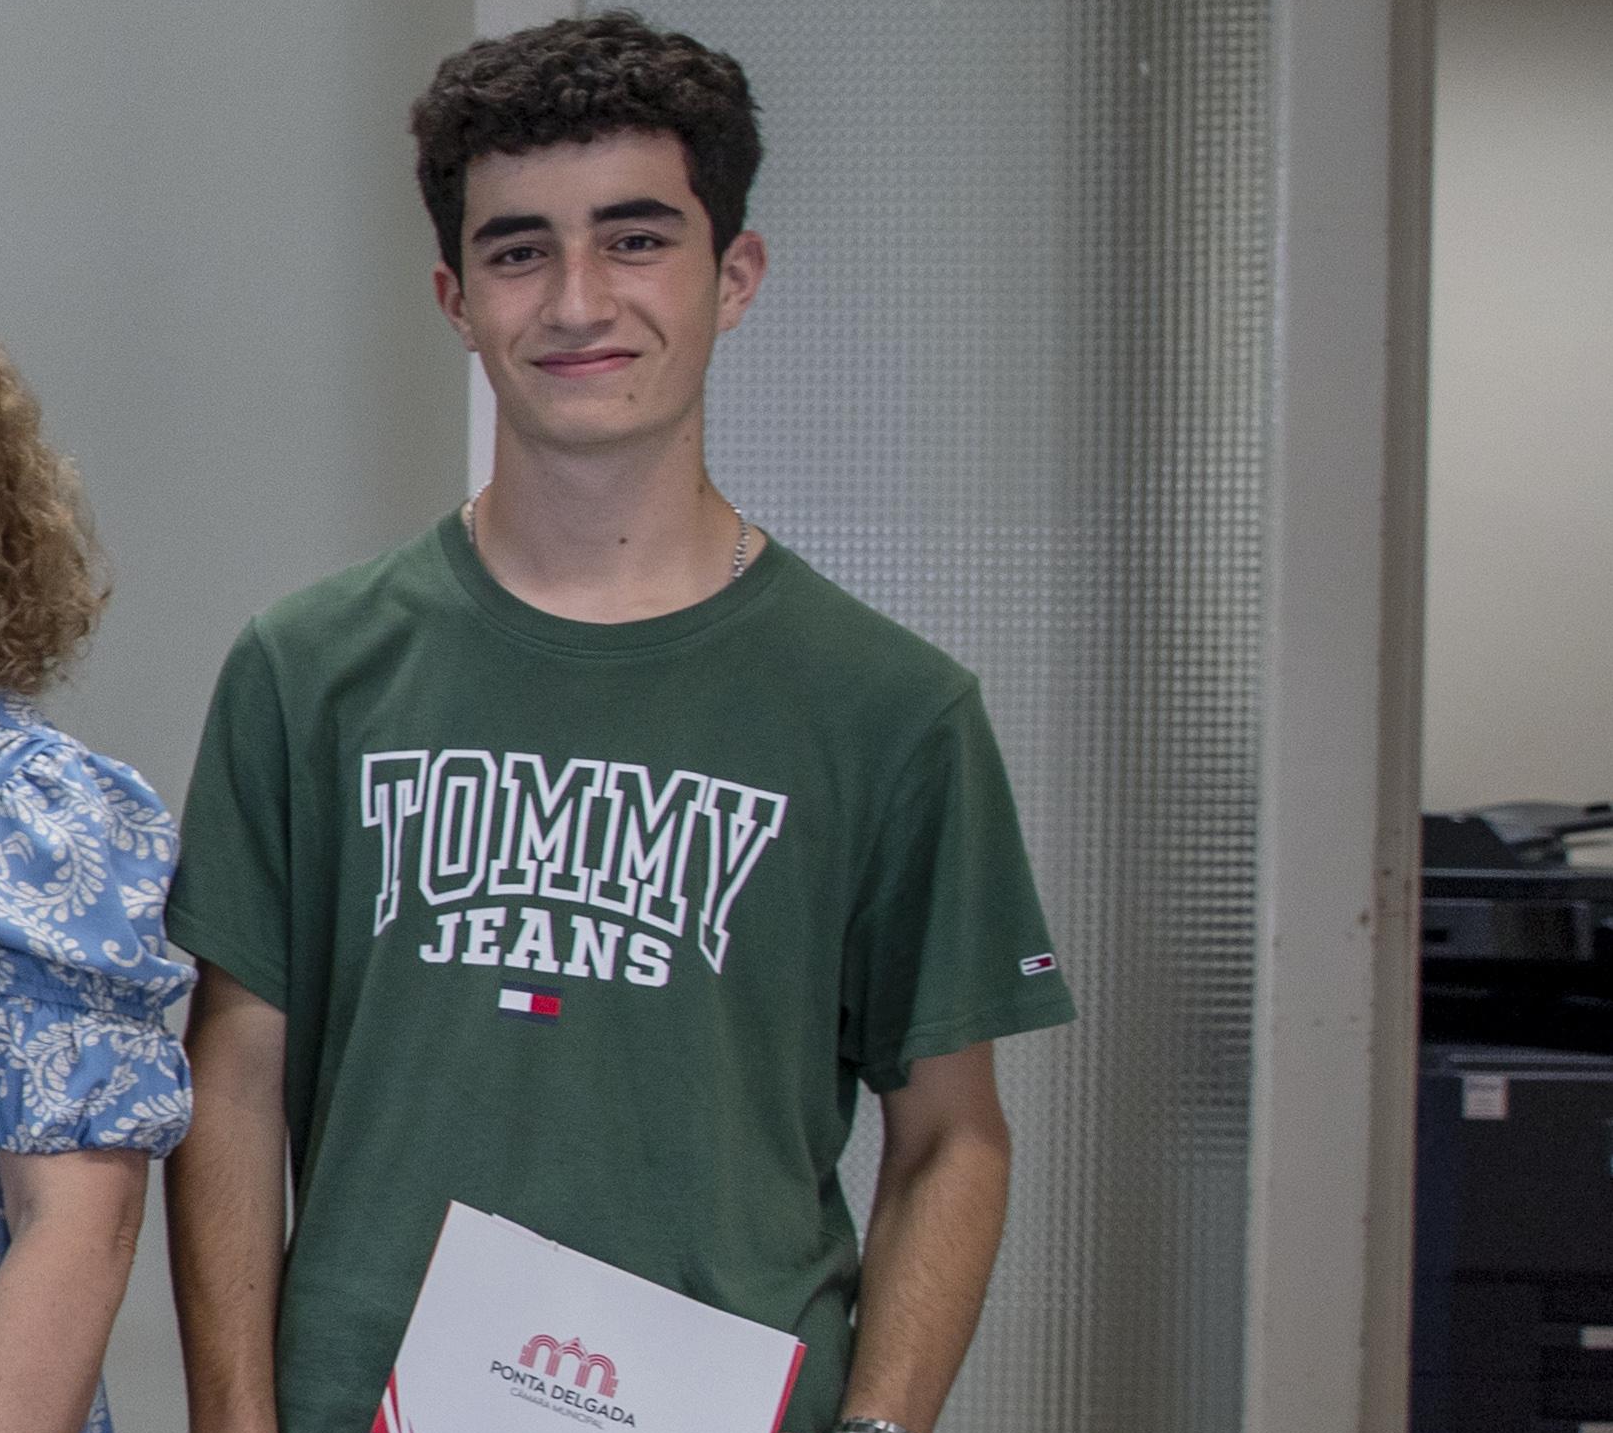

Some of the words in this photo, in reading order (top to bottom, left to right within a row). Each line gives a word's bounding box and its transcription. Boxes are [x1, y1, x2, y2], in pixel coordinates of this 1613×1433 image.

[360, 748, 788, 975] TOMMY
[418, 905, 672, 988] JEANS
[490, 1361, 546, 1395] PONTA
[550, 1385, 636, 1428] DELGADA
